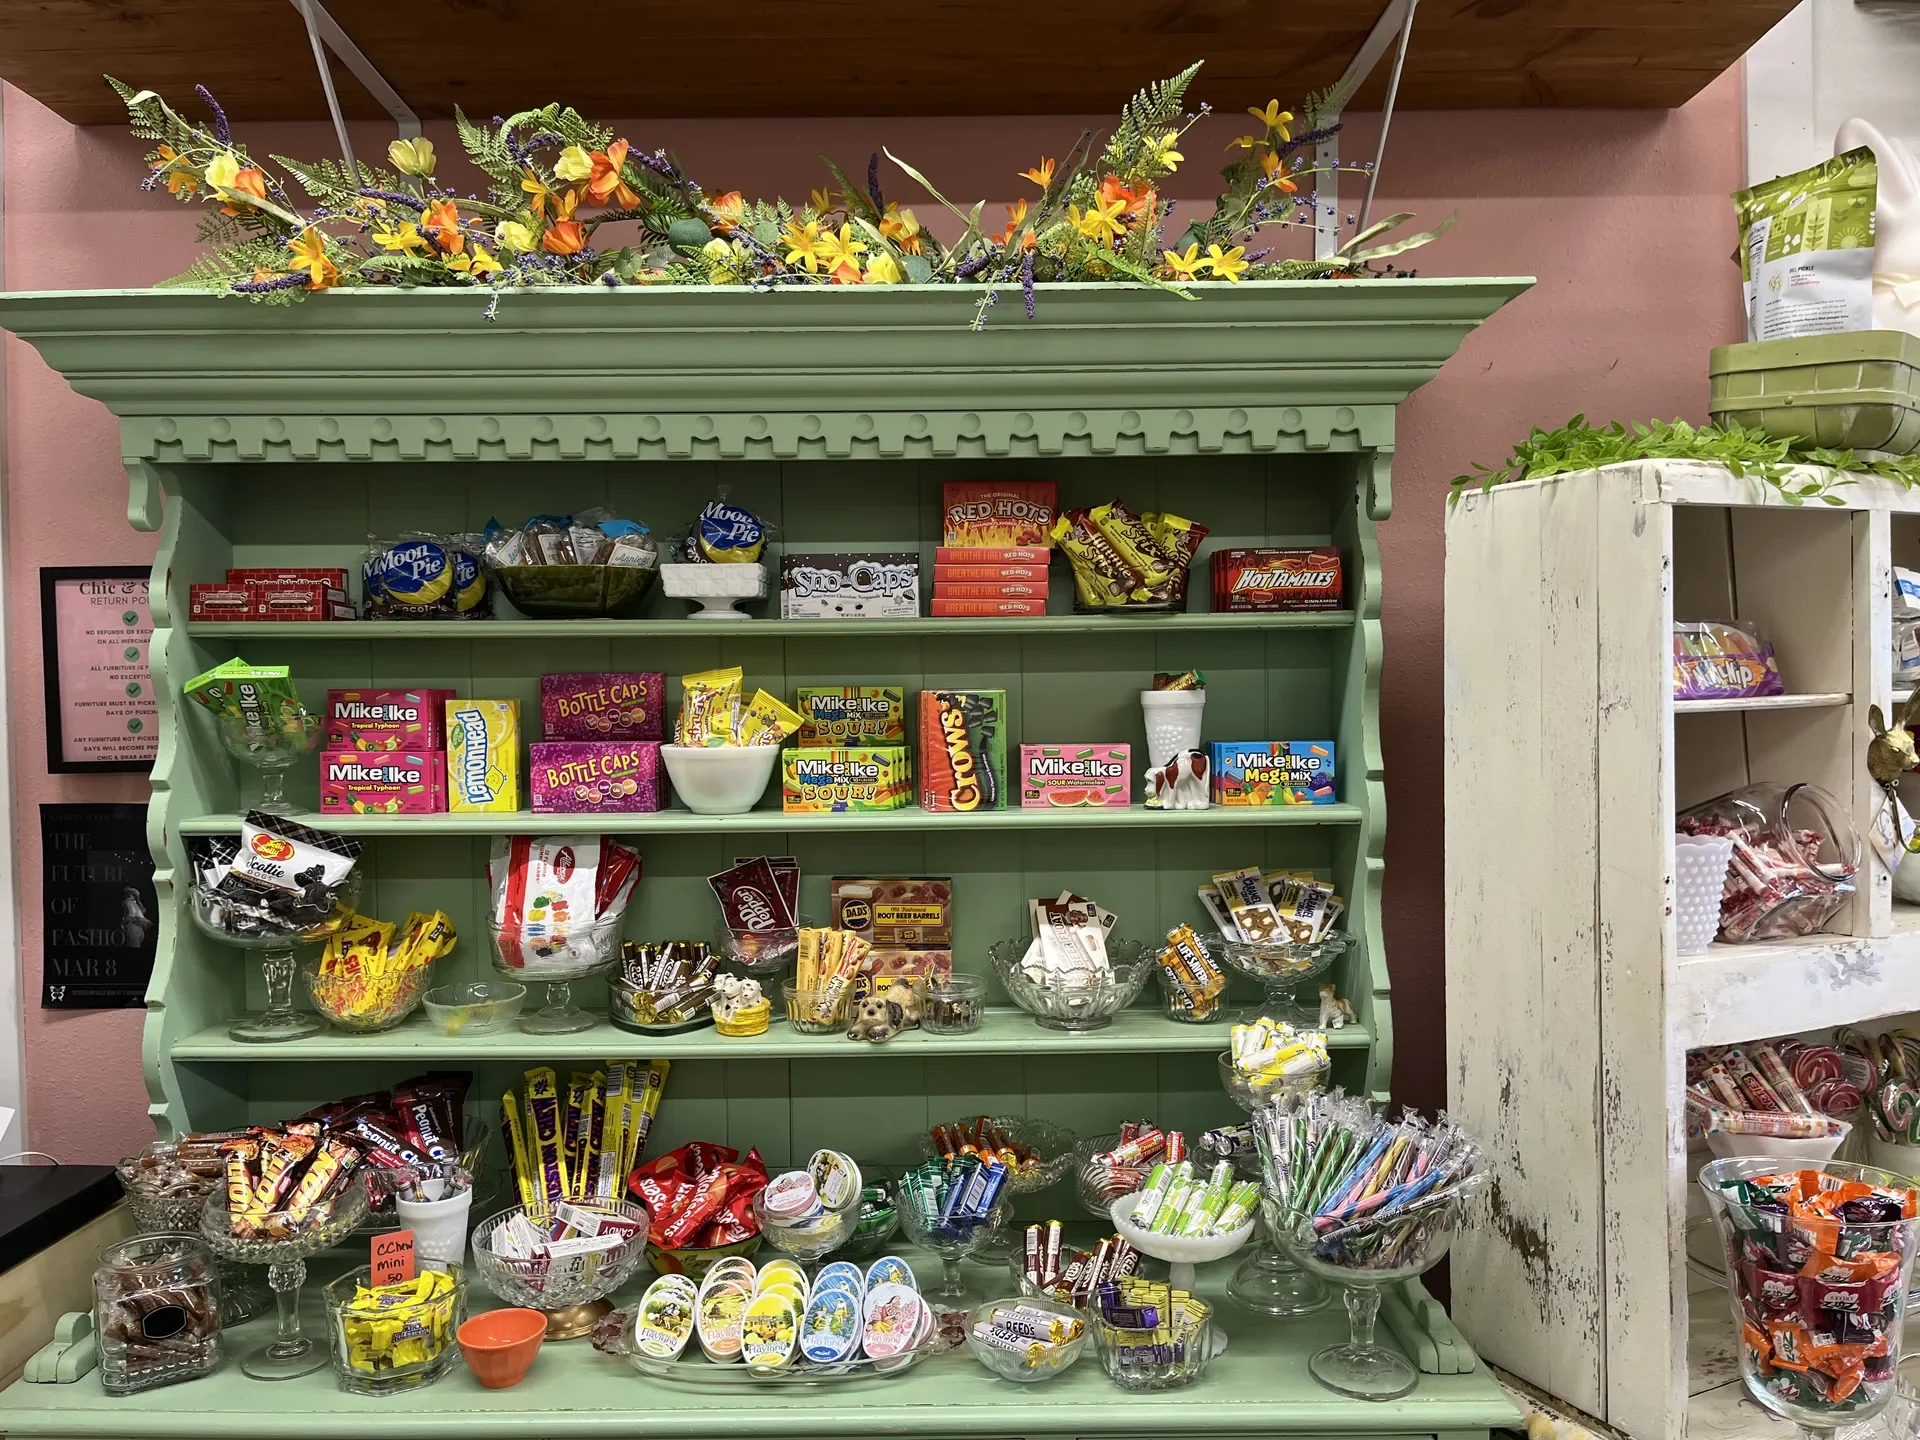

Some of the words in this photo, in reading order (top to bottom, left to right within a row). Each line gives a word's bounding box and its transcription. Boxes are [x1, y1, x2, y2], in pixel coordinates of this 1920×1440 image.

[700, 501, 753, 523] Moon
[948, 501, 993, 523] RED
[994, 500, 1052, 524] HOTS
[725, 522, 760, 543] Pie
[379, 544, 429, 573] Moon
[950, 551, 981, 560] BREATHE
[983, 551, 1001, 560] FIRE!
[1018, 551, 1035, 559] HOTS
[412, 557, 441, 580] Pie
[947, 569, 979, 578] BREATHE
[981, 569, 999, 578] FIRE!
[1015, 569, 1033, 577] HOTS
[79, 581, 116, 594] Chic
[121, 581, 136, 594] &
[795, 570, 841, 597] Sno
[948, 587, 979, 595] BREATHE
[981, 587, 999, 595] FIRE!
[90, 597, 128, 605] RETURN
[946, 604, 977, 612] BREATHE
[979, 604, 997, 612] FIRE!
[558, 689, 610, 717] BOTTLE
[610, 680, 648, 704] CAPS
[811, 696, 857, 710] Mike
[862, 699, 889, 712] Ike
[335, 703, 383, 718] Mike
[389, 705, 418, 720] Ike
[814, 710, 846, 721] Mega
[374, 722, 400, 730] Typhoon
[818, 720, 887, 735] SOUR!
[797, 760, 845, 775] Mike
[850, 762, 878, 776] Ike
[941, 708, 981, 811] Crows
[1031, 758, 1084, 774] Mike
[1090, 760, 1122, 776] Ike
[1236, 753, 1286, 768] Mike
[1291, 755, 1320, 769] Ike
[329, 765, 383, 780] Mike
[389, 767, 420, 782] Ike
[546, 759, 600, 788] BOTTLE
[601, 751, 640, 775] CAPS
[1245, 768, 1290, 784] Mega
[373, 784, 401, 792] Typhoon
[800, 774, 833, 786] Mega
[804, 786, 875, 800] SOUR!
[49, 832, 92, 851] THE
[51, 864, 129, 882] FUTURE
[246, 856, 285, 878] Scottie
[247, 869, 274, 882] DOGS
[1242, 878, 1262, 904] CARAMEL
[50, 897, 79, 915] OF
[737, 890, 776, 933] Pepper
[737, 904, 757, 922] Dr
[845, 906, 868, 918] DAD'S
[1302, 890, 1320, 919] CARAMEL
[51, 929, 126, 947] FASHIO
[52, 958, 100, 976] MAR
[105, 958, 118, 976] 8
[412, 1104, 441, 1146] Peanut
[357, 1123, 401, 1155] Peanut
[602, 1225, 634, 1239] CANDY
[1006, 1320, 1035, 1336] REED'S
